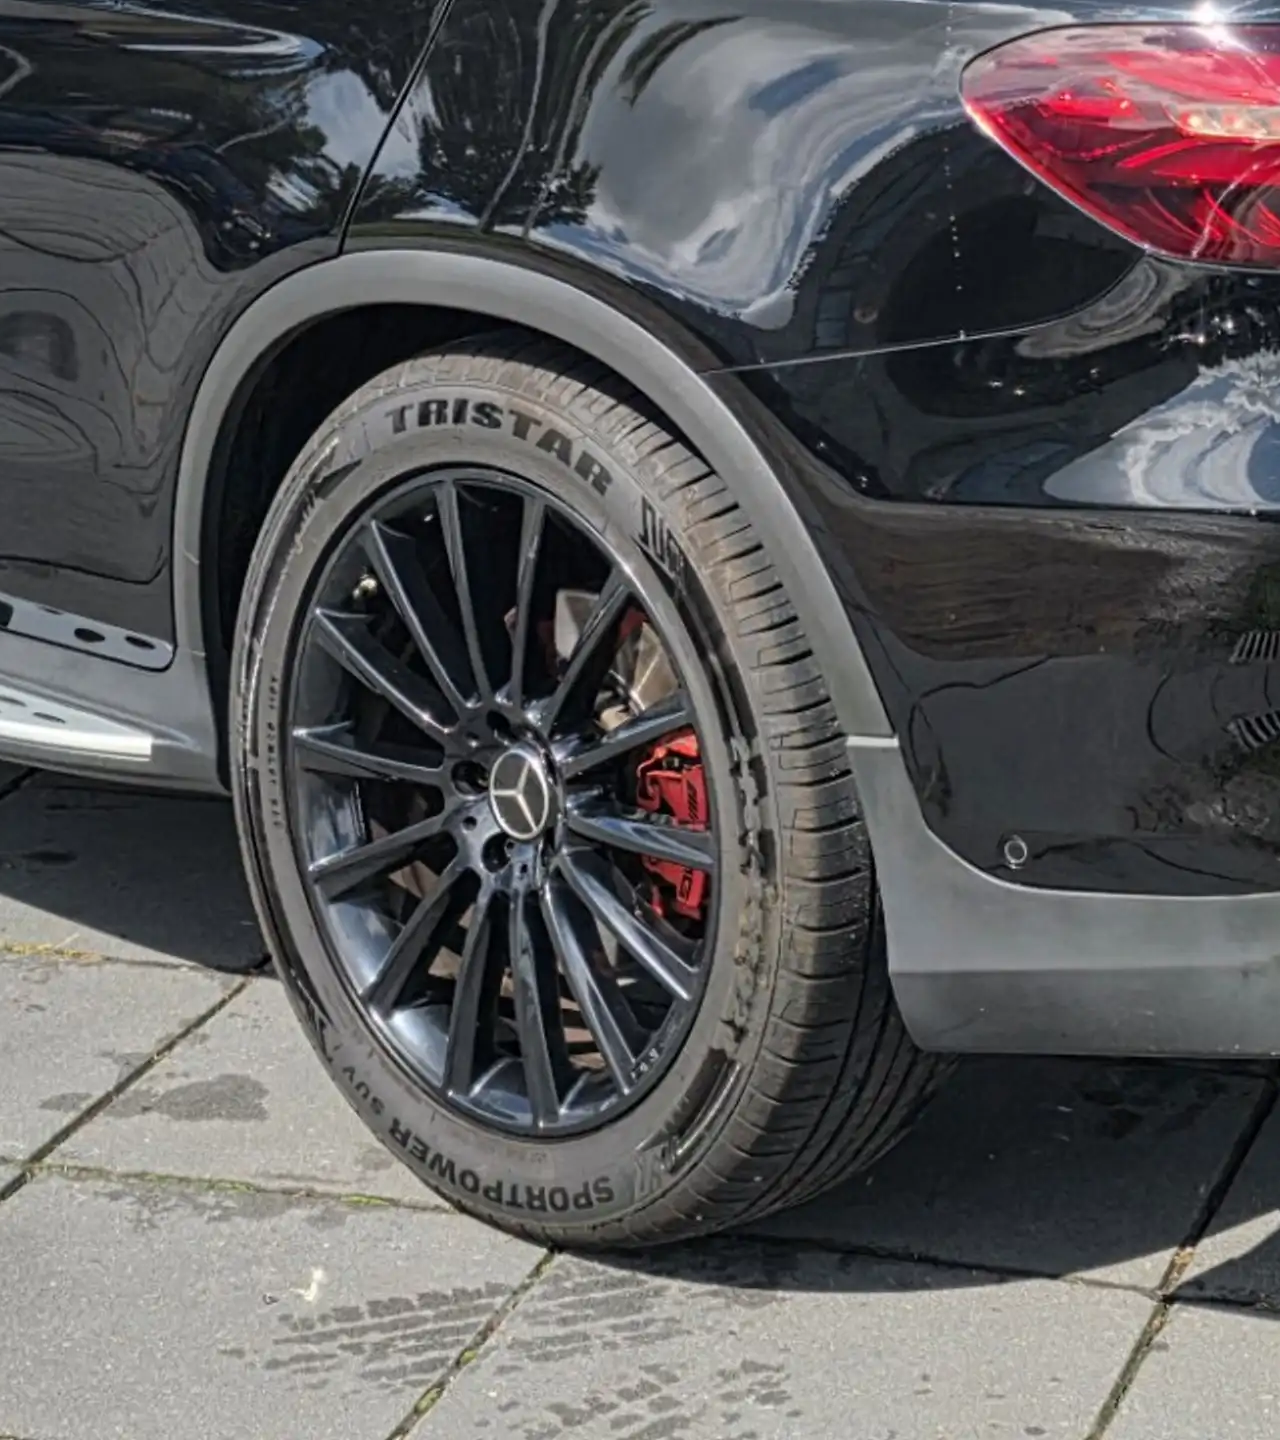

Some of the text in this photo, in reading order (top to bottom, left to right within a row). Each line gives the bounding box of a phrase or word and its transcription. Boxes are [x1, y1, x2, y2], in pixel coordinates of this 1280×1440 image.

[384, 398, 613, 496] TRISTAR
[342, 1065, 615, 1212] SPORTPOWER SUV
